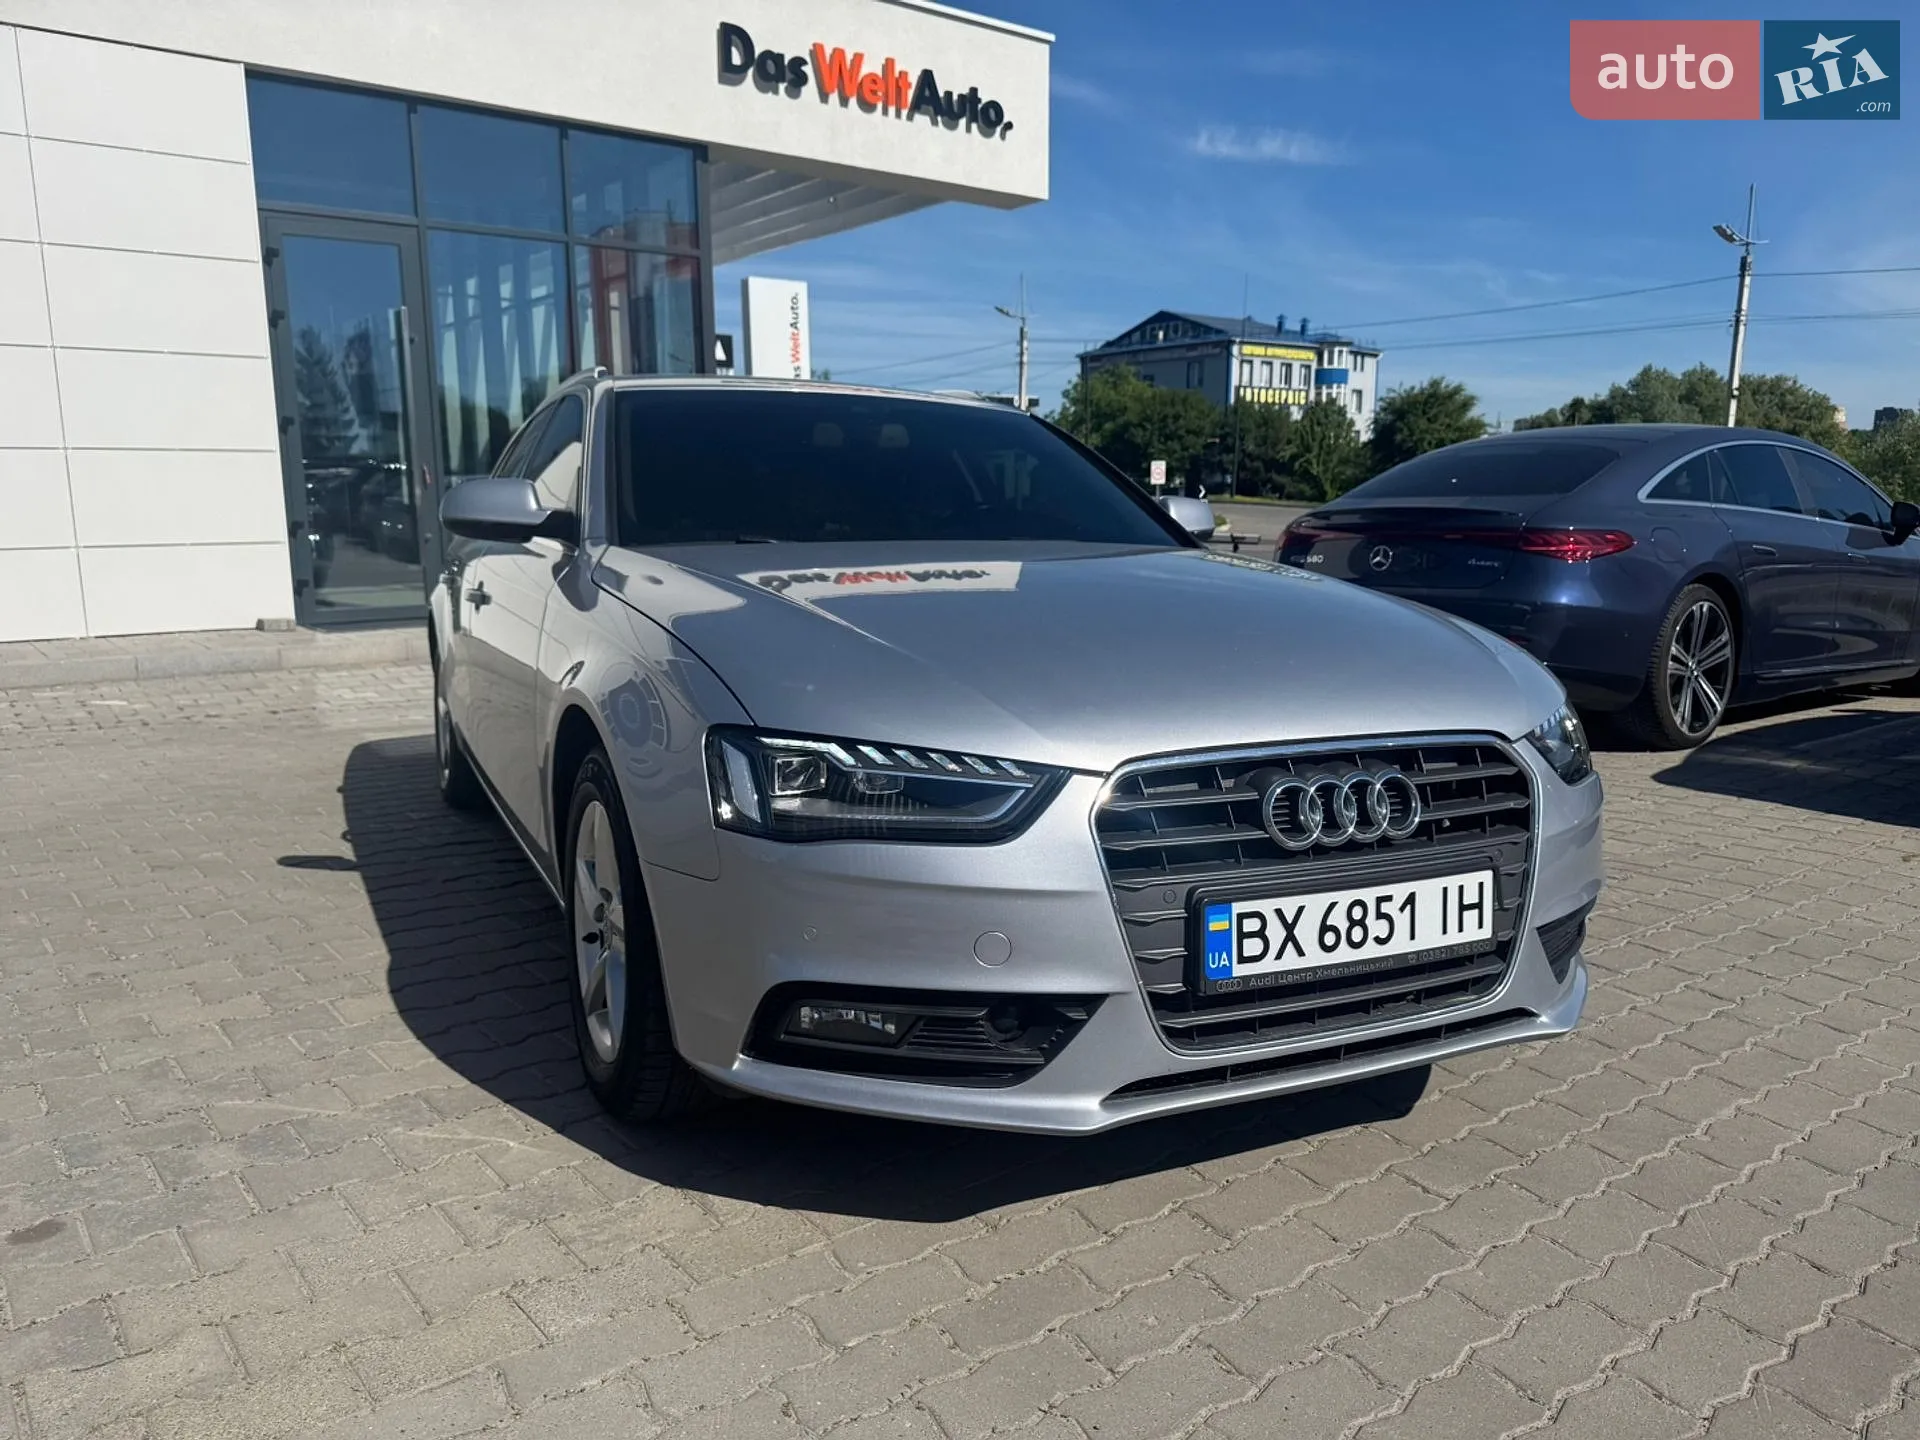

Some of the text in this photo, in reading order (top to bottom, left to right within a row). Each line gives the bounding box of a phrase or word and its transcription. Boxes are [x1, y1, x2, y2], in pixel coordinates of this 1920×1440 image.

[1236, 881, 1485, 965] BX 6851 IH
[1208, 951, 1230, 969] UA
[1249, 974, 1275, 988] Audi
[1279, 971, 1313, 985] Центр
